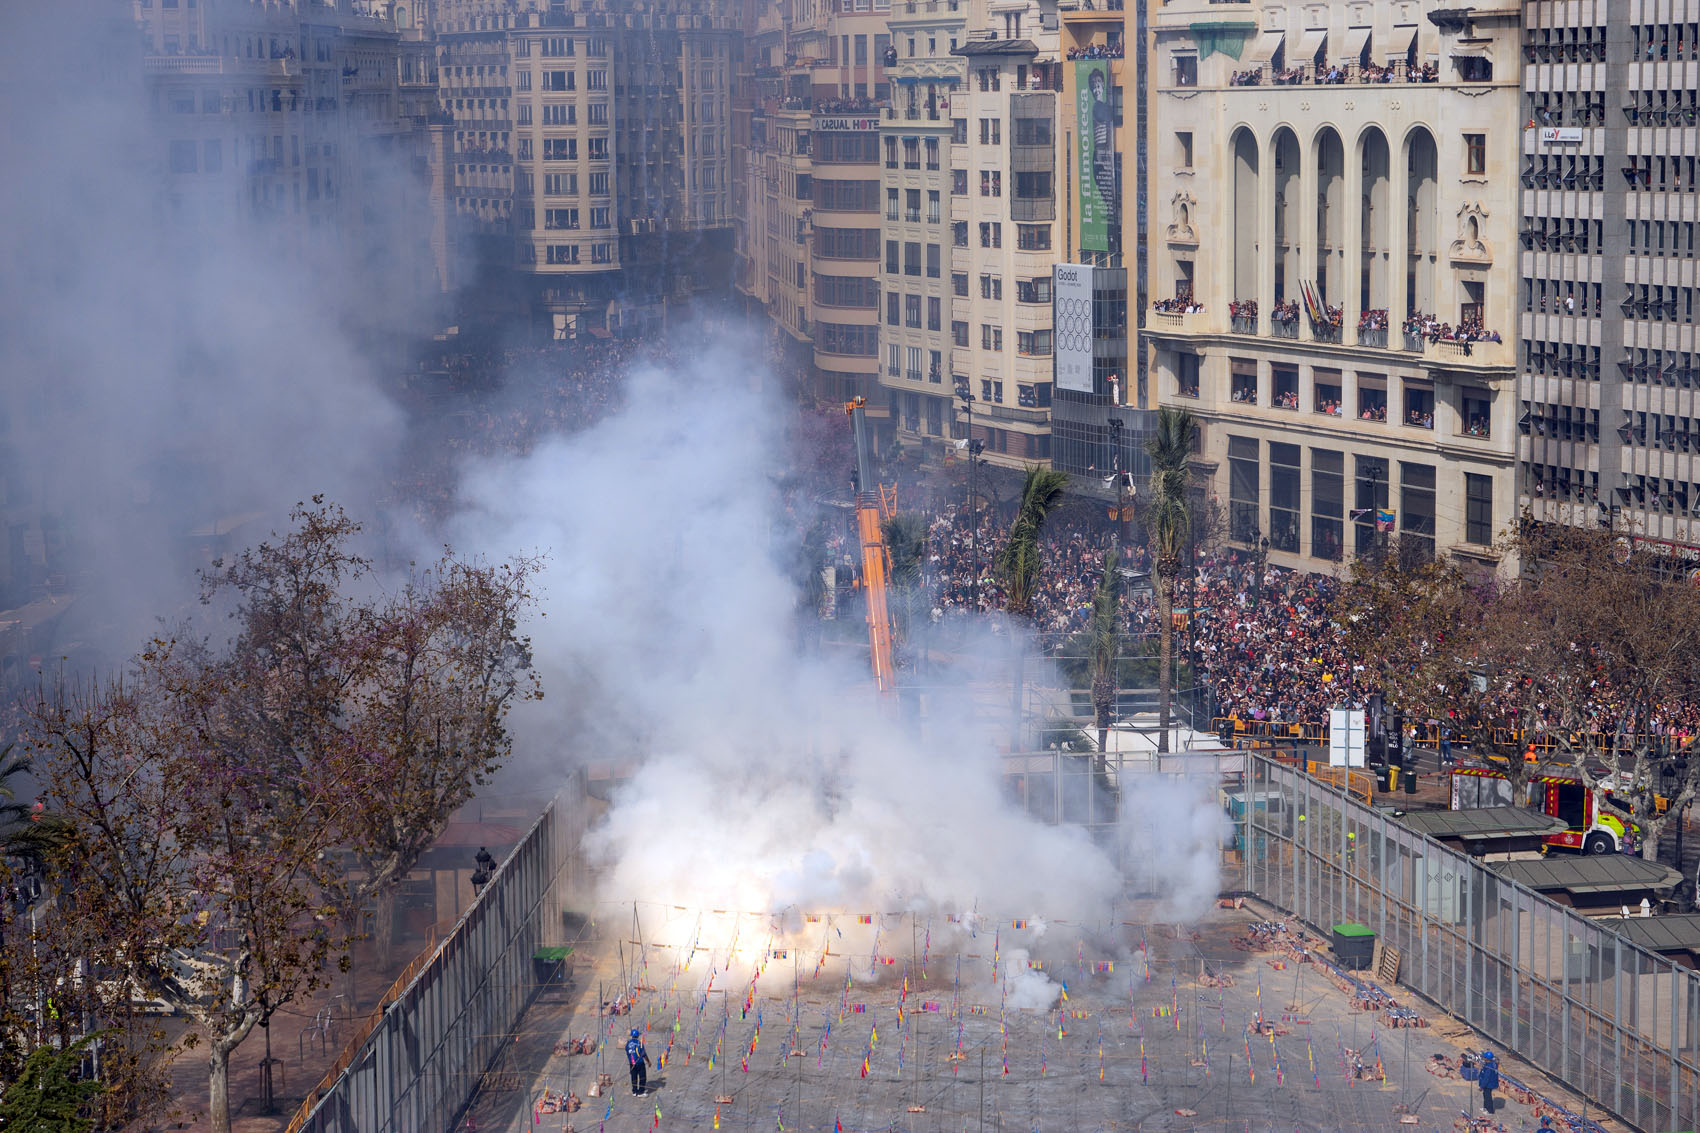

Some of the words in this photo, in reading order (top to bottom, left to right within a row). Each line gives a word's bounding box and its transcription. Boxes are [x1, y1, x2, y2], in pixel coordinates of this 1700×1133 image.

[853, 120, 879, 130] HOTE
[1081, 88, 1091, 199] filmoteca
[1083, 203, 1093, 224] la
[1058, 268, 1078, 282] Godot
